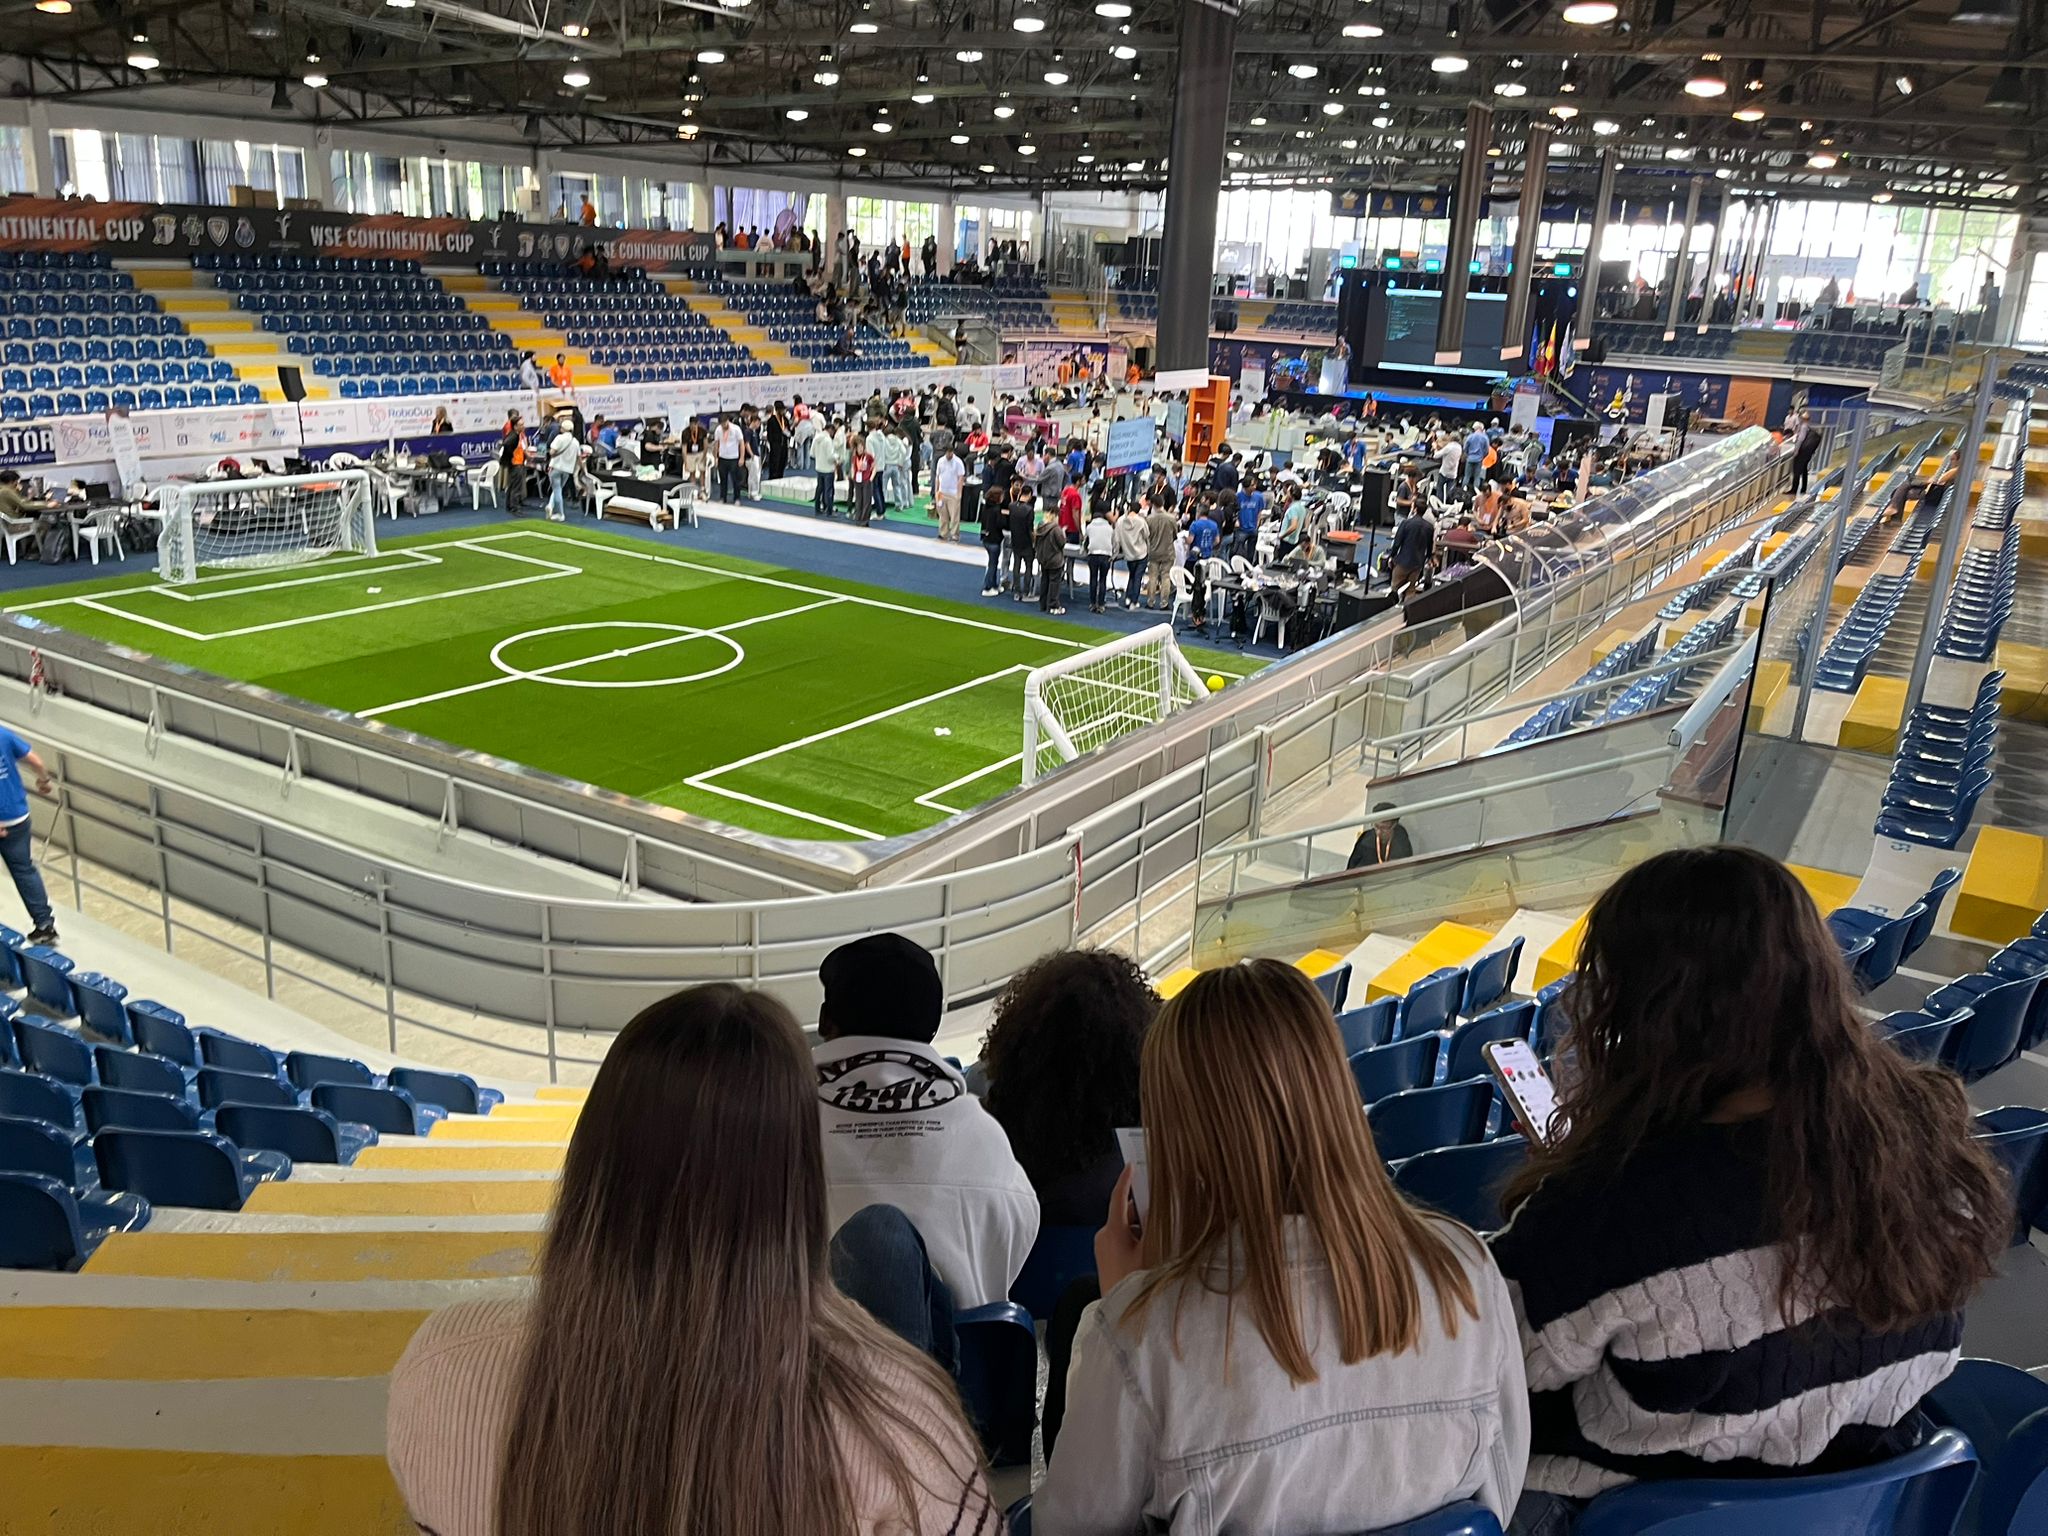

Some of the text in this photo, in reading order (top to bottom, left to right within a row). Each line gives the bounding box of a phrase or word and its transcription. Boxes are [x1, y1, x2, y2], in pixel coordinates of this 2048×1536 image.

[104, 217, 145, 243] CUP
[310, 224, 475, 254] WSE CONTINENTAL CUP
[619, 240, 686, 262] CONTINENTAL
[688, 244, 709, 262] CUP
[388, 407, 433, 420] RoboCup
